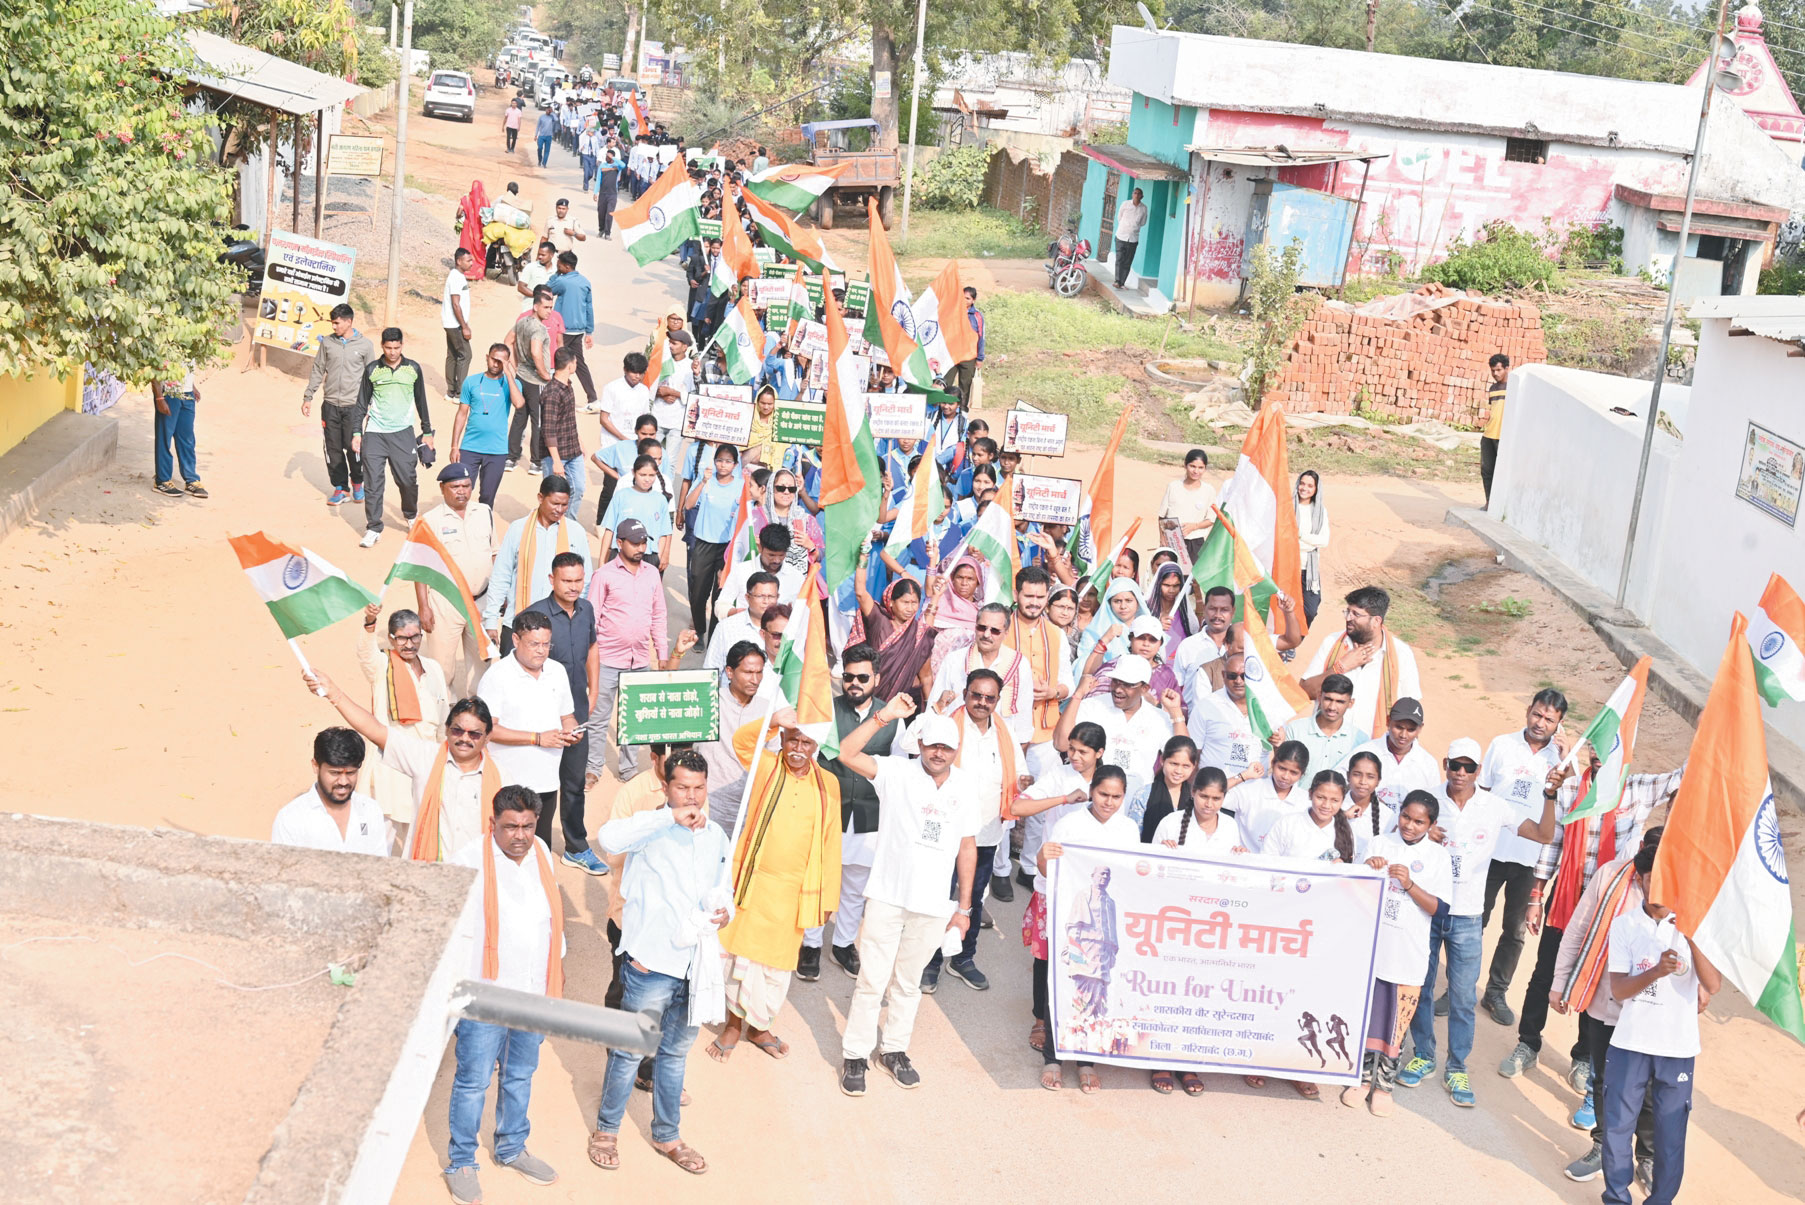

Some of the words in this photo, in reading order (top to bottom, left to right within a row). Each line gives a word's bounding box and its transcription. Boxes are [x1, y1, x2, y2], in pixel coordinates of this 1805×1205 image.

[283, 252, 294, 262] एवं
[701, 406, 724, 419] यूनिटी
[725, 412, 742, 420] मार्च
[873, 404, 896, 416] यूनिटी
[896, 404, 912, 414] मार्च
[1020, 422, 1040, 432] यूनिटी
[1041, 424, 1056, 432] मार्च
[1026, 486, 1050, 498] यूनिटी
[1051, 489, 1068, 500] मार्च
[639, 692, 657, 702] शराब
[658, 690, 666, 702] से
[666, 692, 681, 702] नाता
[634, 706, 658, 722] खुशियों
[660, 706, 667, 718] से
[668, 708, 683, 718] नाता
[649, 733, 661, 743] मुक्त
[678, 730, 702, 738] अभियान
[1188, 894, 1248, 908] सरदार@150
[1124, 905, 1233, 958] यूनिटी
[1238, 919, 1314, 958] मार्च
[1120, 970, 1176, 997] "Run
[1184, 976, 1214, 999] for
[1220, 978, 1295, 1010] Unity"
[1154, 1005, 1192, 1017] शासकीय
[1194, 1006, 1210, 1018] वीर
[1212, 1008, 1255, 1022] सुरेन्द्रसाय
[1132, 1020, 1180, 1034] स्नातकोत्तर
[1182, 1024, 1232, 1038] महाविद्यालय
[1236, 1028, 1275, 1042] गरियाबंद
[1150, 1039, 1172, 1052] जिला
[1181, 1042, 1220, 1055] गरियाबंद
